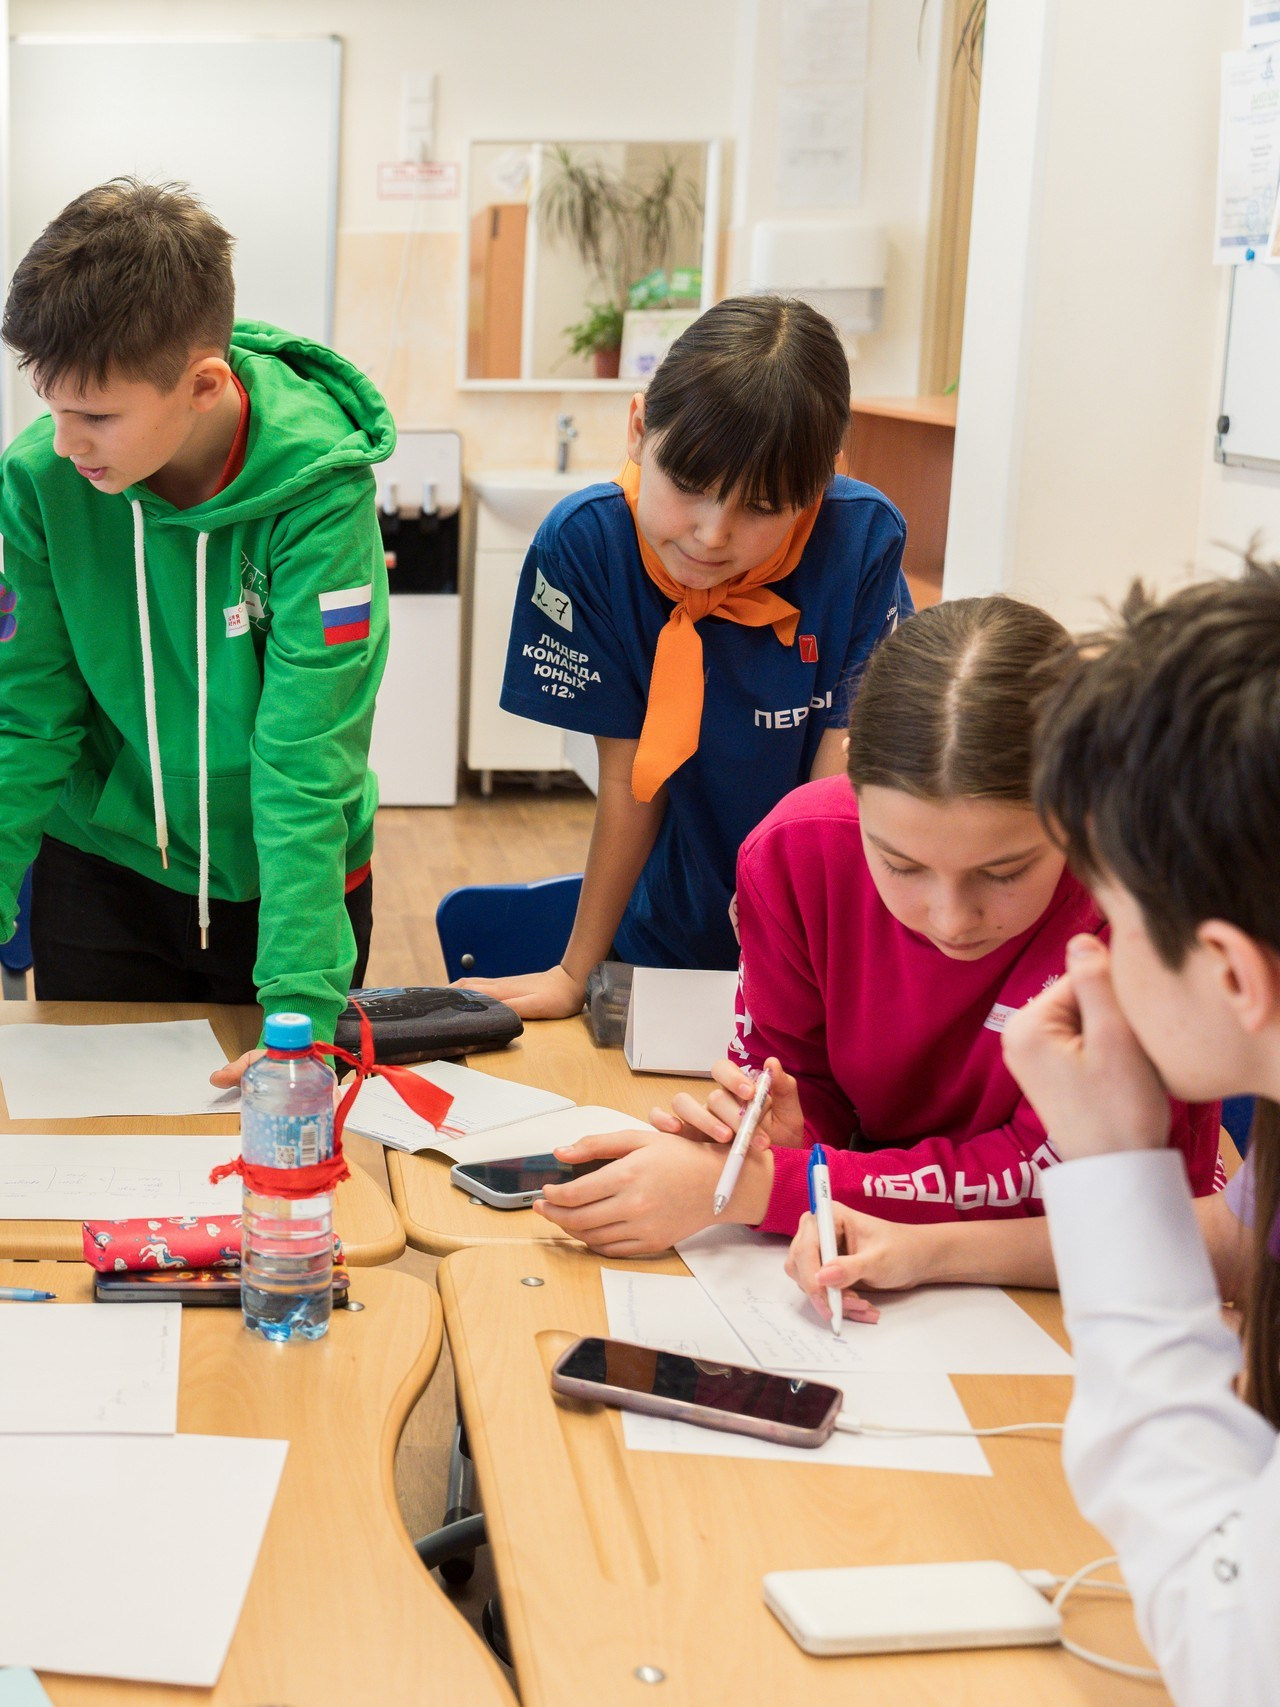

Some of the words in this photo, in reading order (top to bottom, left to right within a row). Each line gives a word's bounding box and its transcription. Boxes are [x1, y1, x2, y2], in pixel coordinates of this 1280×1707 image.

[537, 581, 569, 620] 2.7
[522, 644, 602, 683] КОМАНДА
[538, 633, 589, 664] ЛИДЕР
[533, 663, 587, 691] ЮНЫХ
